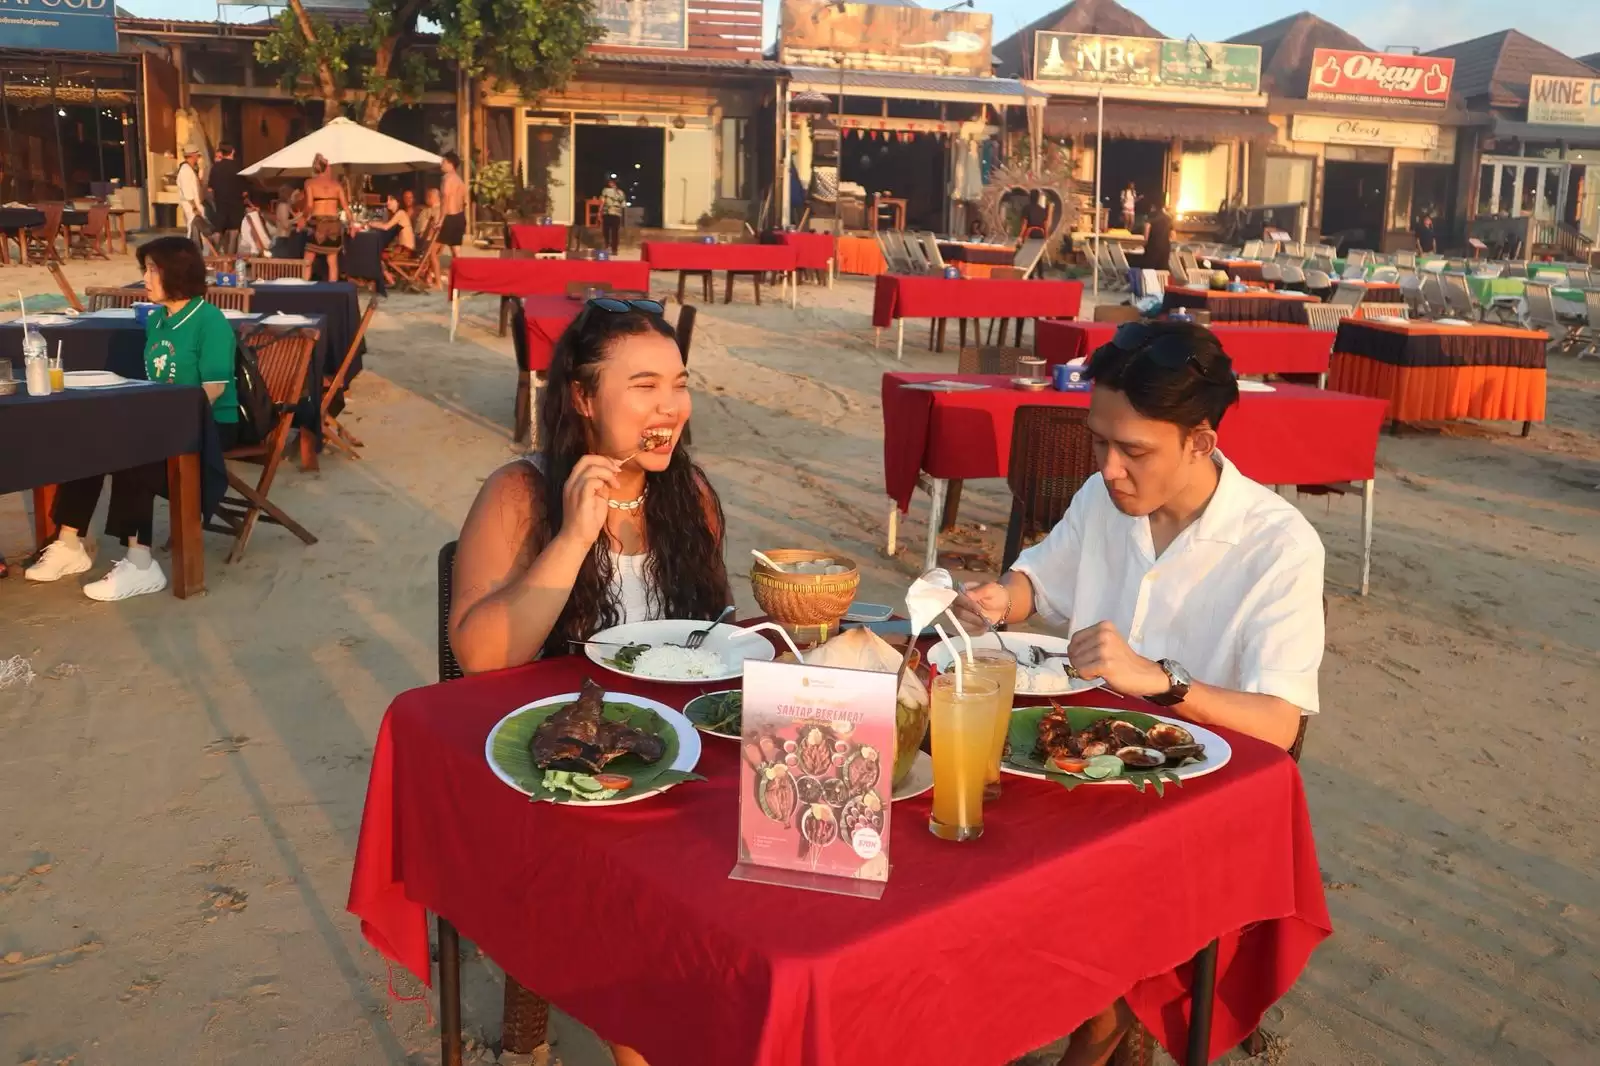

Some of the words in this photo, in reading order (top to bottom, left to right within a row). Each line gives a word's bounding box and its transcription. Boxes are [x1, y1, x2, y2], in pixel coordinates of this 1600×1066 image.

[1076, 41, 1150, 73] NBC
[1343, 55, 1424, 91] Okay
[1534, 79, 1584, 104] WINE
[1336, 120, 1380, 138] Okay
[776, 704, 812, 718] SANTAP
